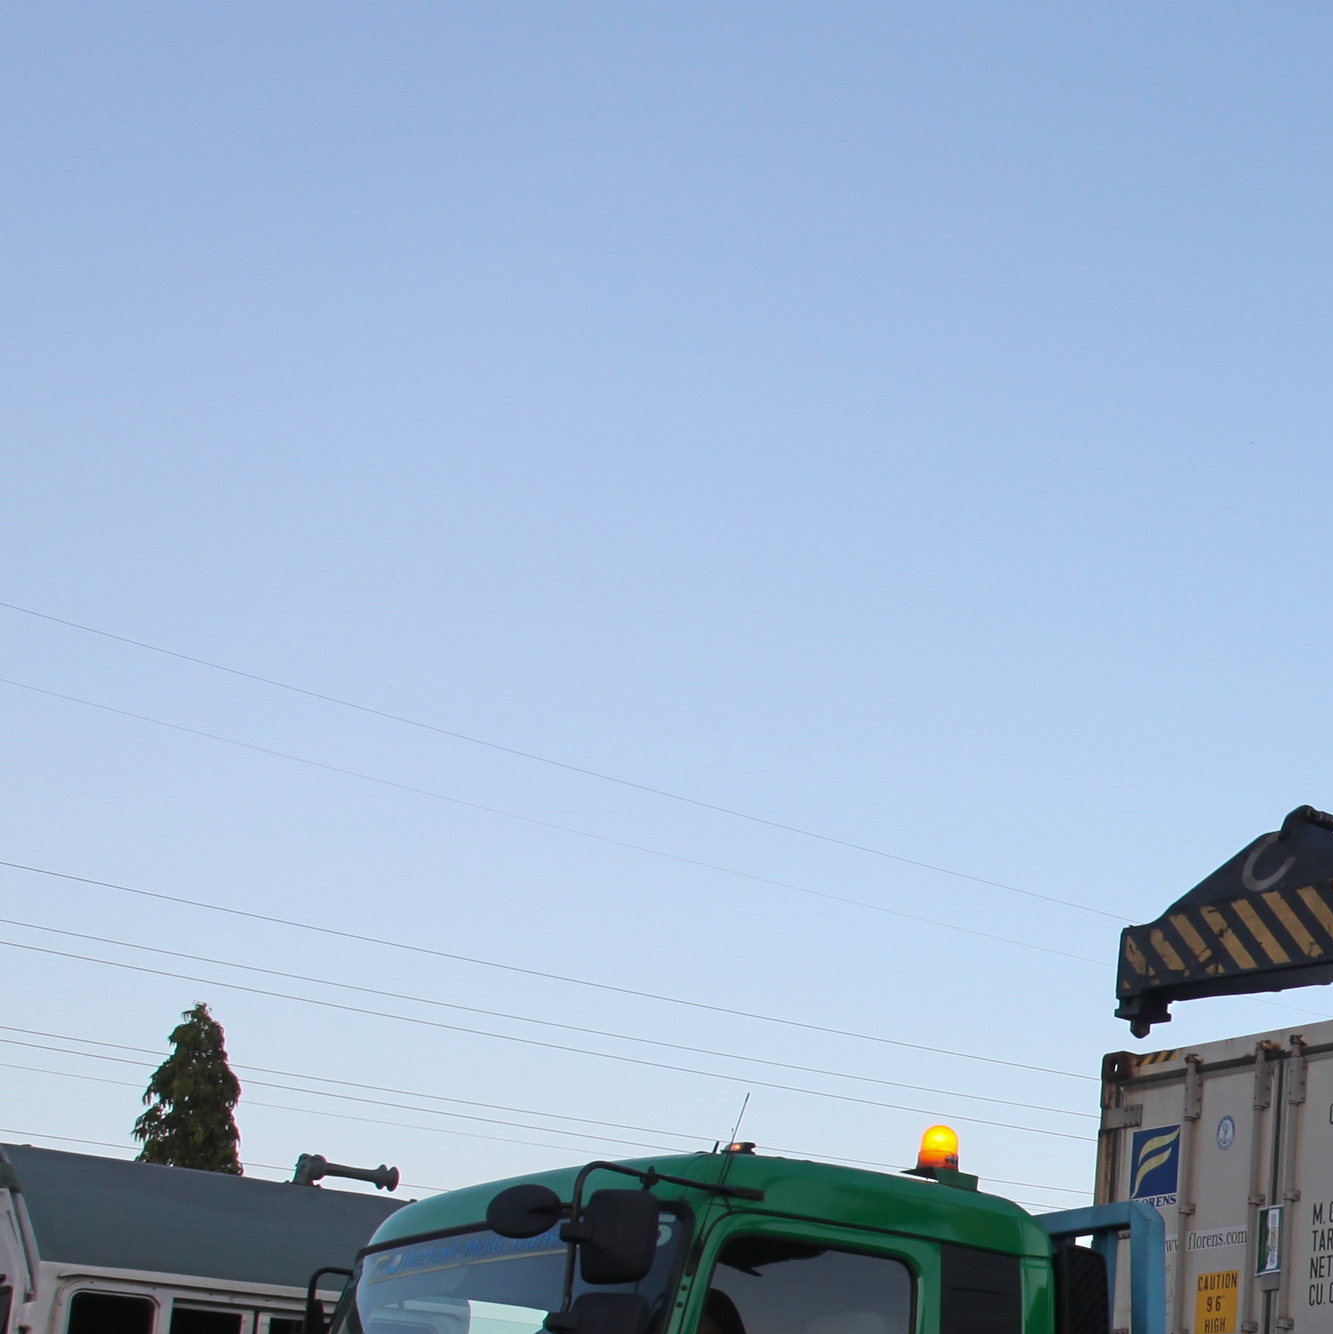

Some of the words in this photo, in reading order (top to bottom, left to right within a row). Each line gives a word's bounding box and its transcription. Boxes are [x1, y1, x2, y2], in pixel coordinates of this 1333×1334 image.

[1309, 1255, 1333, 1279] NET
[1197, 1272, 1238, 1291] CAUTION
[1204, 1317, 1226, 1334] HIGH
